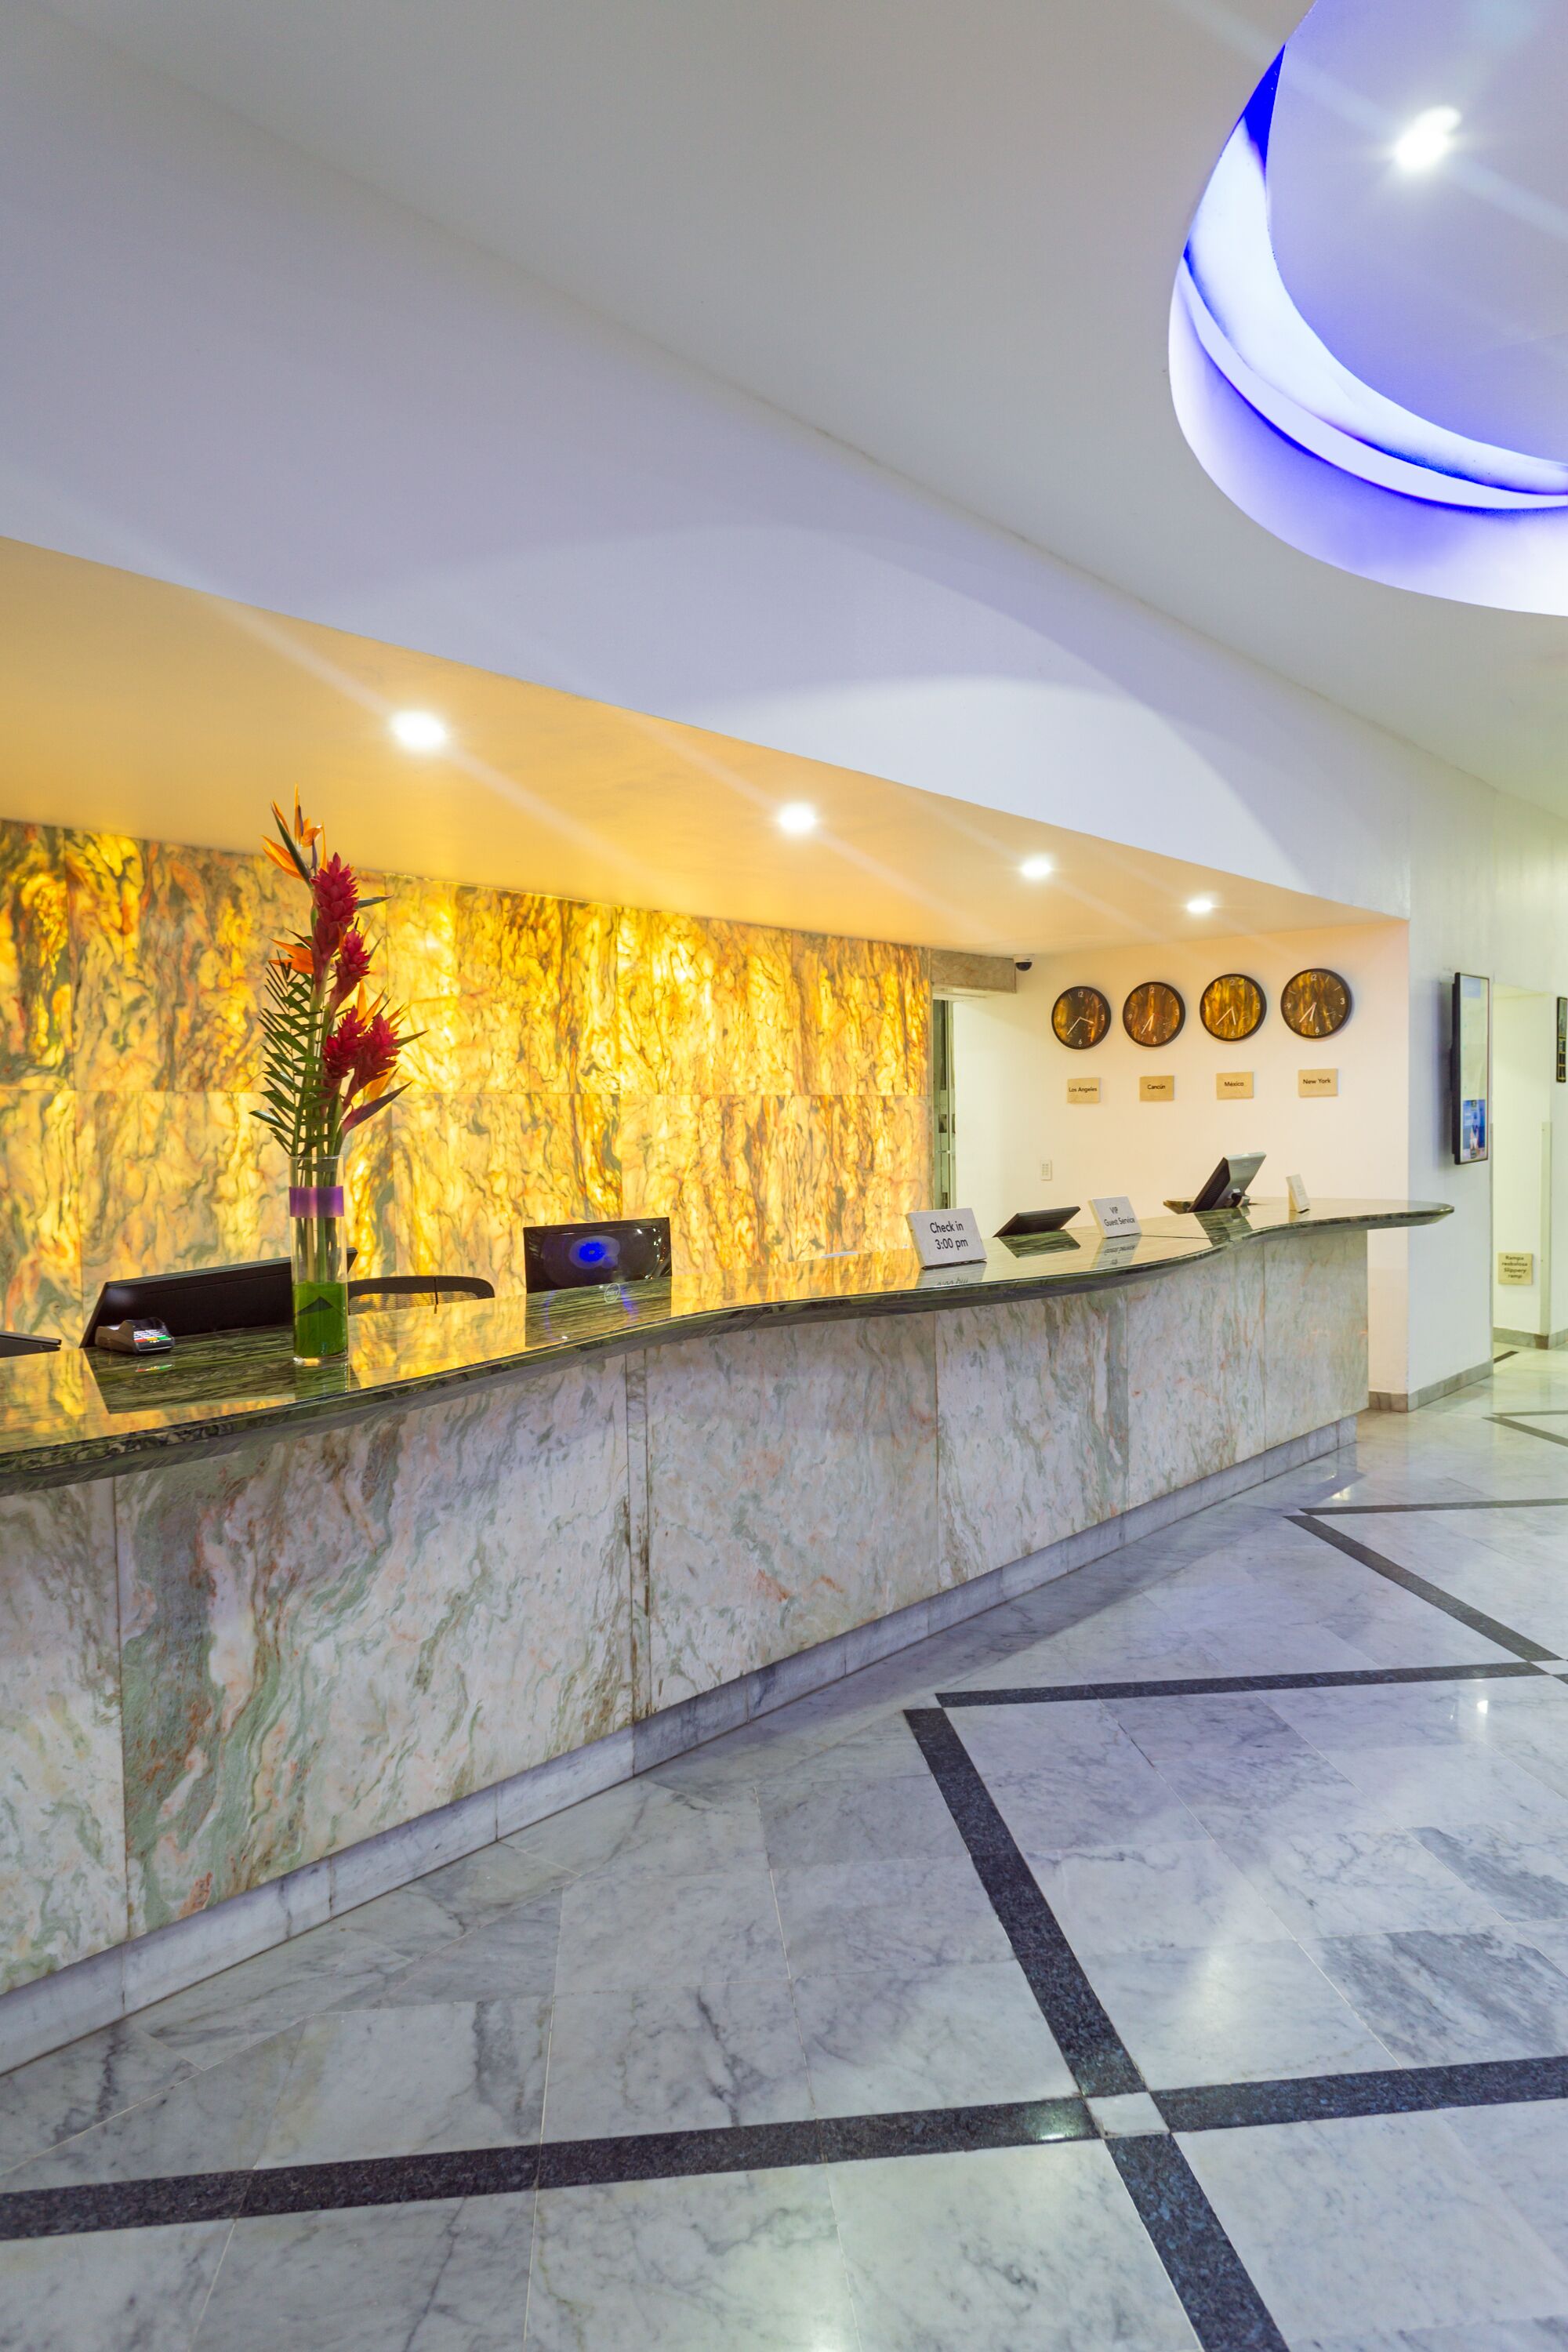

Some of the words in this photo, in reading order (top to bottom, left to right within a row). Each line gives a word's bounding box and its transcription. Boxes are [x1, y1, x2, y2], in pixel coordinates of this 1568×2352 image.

[930, 1221, 955, 1234] Check
[954, 1221, 964, 1231] in
[1104, 1218, 1119, 1227] Guest
[935, 1238, 954, 1250] 3:00
[955, 1239, 969, 1250] pm
